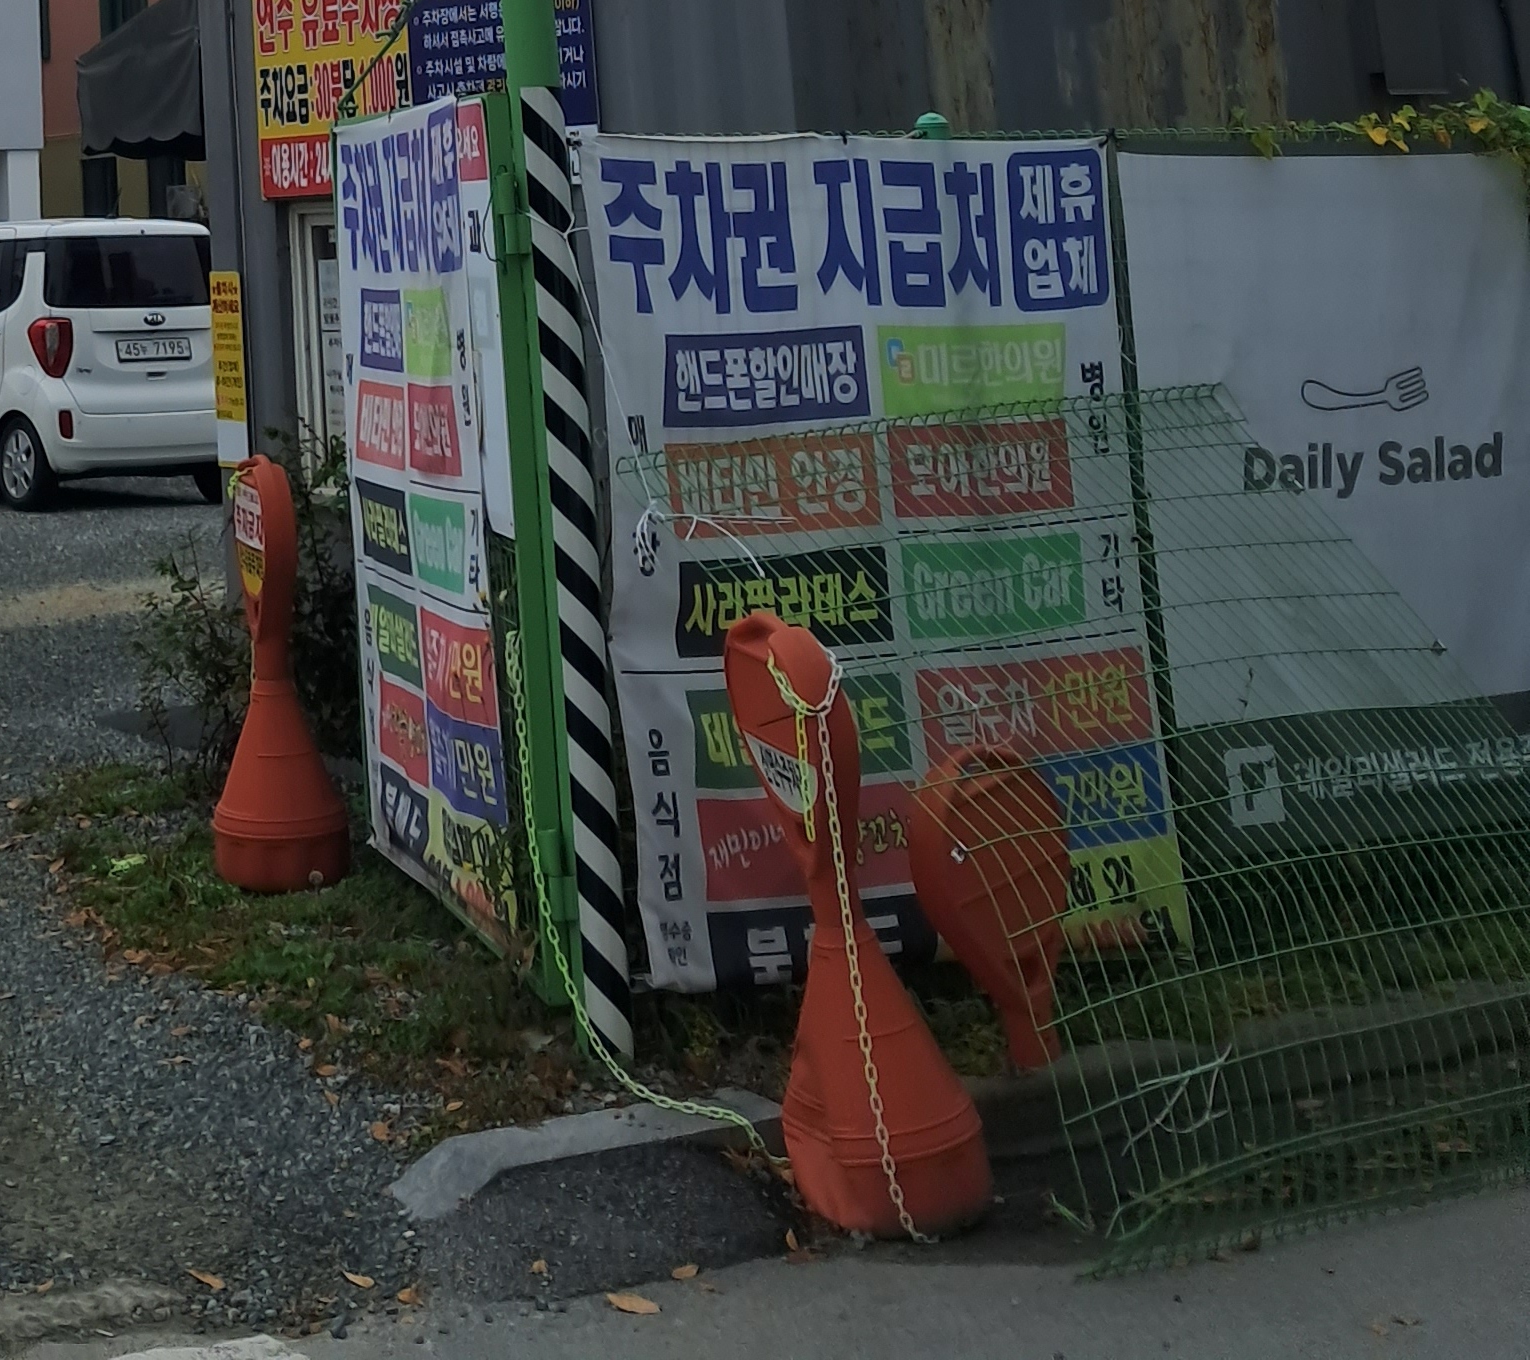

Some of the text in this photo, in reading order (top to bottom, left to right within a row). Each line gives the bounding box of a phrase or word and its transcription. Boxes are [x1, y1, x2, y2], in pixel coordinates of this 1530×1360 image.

[422, 4, 477, 26] 주차장에서는
[425, 57, 463, 77] 주차시설
[464, 55, 475, 73] 및
[341, 128, 431, 273] 주차권 지급처
[1018, 162, 1097, 226] 제휴
[600, 157, 1002, 314] 주차권 지급처
[1021, 235, 1101, 301] 업체
[153, 341, 185, 356] 7195
[674, 339, 858, 412] 핸드폰할인매장
[790, 446, 867, 515] 안경
[1244, 431, 1505, 498] Daily Salad
[913, 552, 1075, 621] Green Car
[646, 728, 684, 902] 음식점
